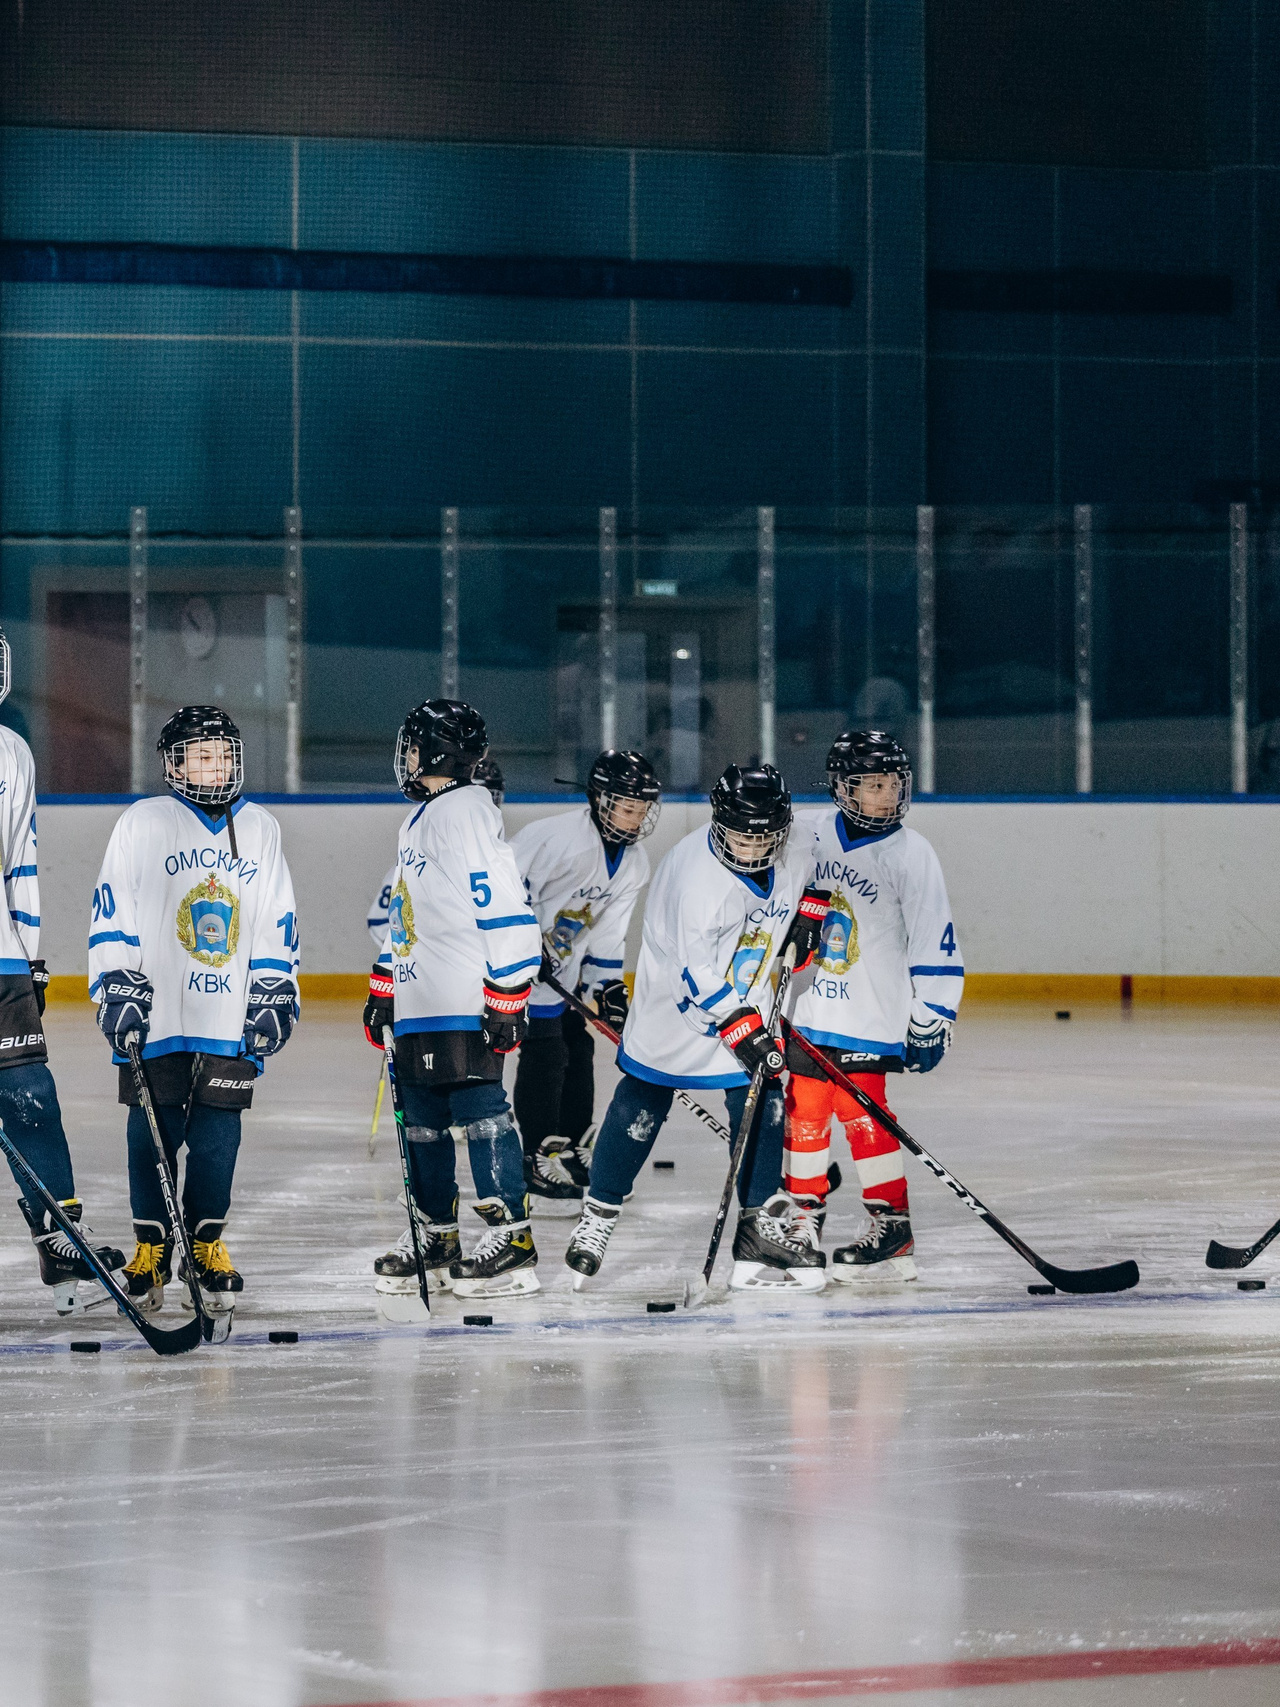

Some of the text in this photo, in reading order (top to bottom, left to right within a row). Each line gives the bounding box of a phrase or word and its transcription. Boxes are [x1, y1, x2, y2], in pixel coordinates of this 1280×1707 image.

[165, 848, 258, 885] ОМСКИЙ
[816, 861, 878, 904] МСКИЙ
[469, 871, 492, 908] 5
[939, 922, 957, 957] 4
[107, 984, 153, 1001] BAUE
[189, 971, 231, 993] КВК
[812, 976, 850, 1000] КВК
[841, 1052, 881, 1063] CCM
[909, 1034, 941, 1049] USSIA
[916, 1153, 988, 1216] CCM
[156, 1162, 187, 1258] FISCHER
